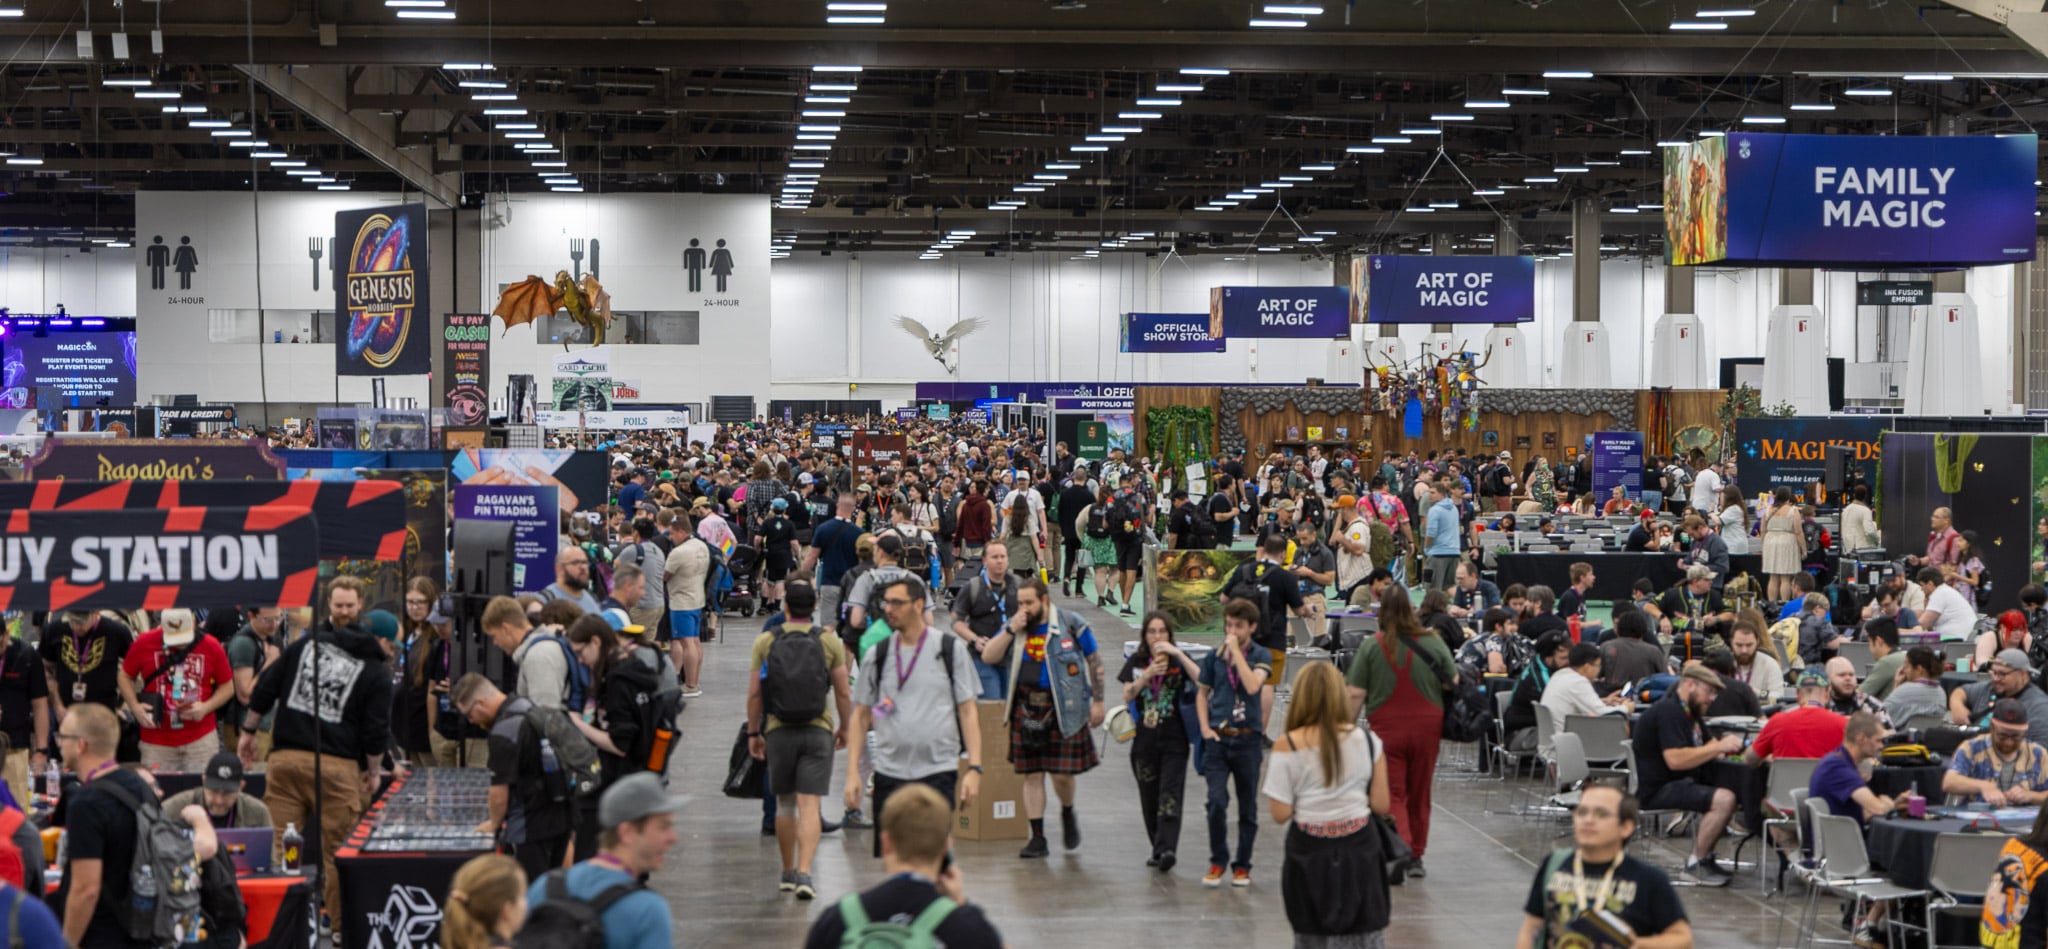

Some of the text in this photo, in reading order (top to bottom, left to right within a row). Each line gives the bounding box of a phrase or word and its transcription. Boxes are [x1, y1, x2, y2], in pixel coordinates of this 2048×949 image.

[1815, 166, 1956, 195] FAMILY
[1823, 200, 1946, 228] MAGIC
[1415, 272, 1493, 288] ART OF
[350, 276, 412, 304] GENESIS
[168, 297, 205, 305] 24-HOUR
[704, 299, 740, 307] 24-HOUR
[1420, 290, 1489, 306] MAGIC
[1891, 296, 1917, 304] EMPIRE
[367, 303, 394, 312] HOBBIES
[1257, 299, 1318, 312] ART OF
[450, 316, 484, 325] WE PAY
[1260, 313, 1314, 326] MAGIC
[444, 326, 489, 341] CASH
[1154, 323, 1205, 333] OFFICIAL
[1143, 332, 1177, 341] SHOW
[180, 410, 190, 418] IN
[191, 410, 223, 418] CREDIT!
[623, 417, 648, 425] FOILS
[1770, 475, 1782, 483] We
[1783, 475, 1801, 483] Make
[477, 494, 536, 506] RAGAVAN'S
[474, 506, 538, 517] PIN TRADING
[71, 534, 279, 582] STATION
